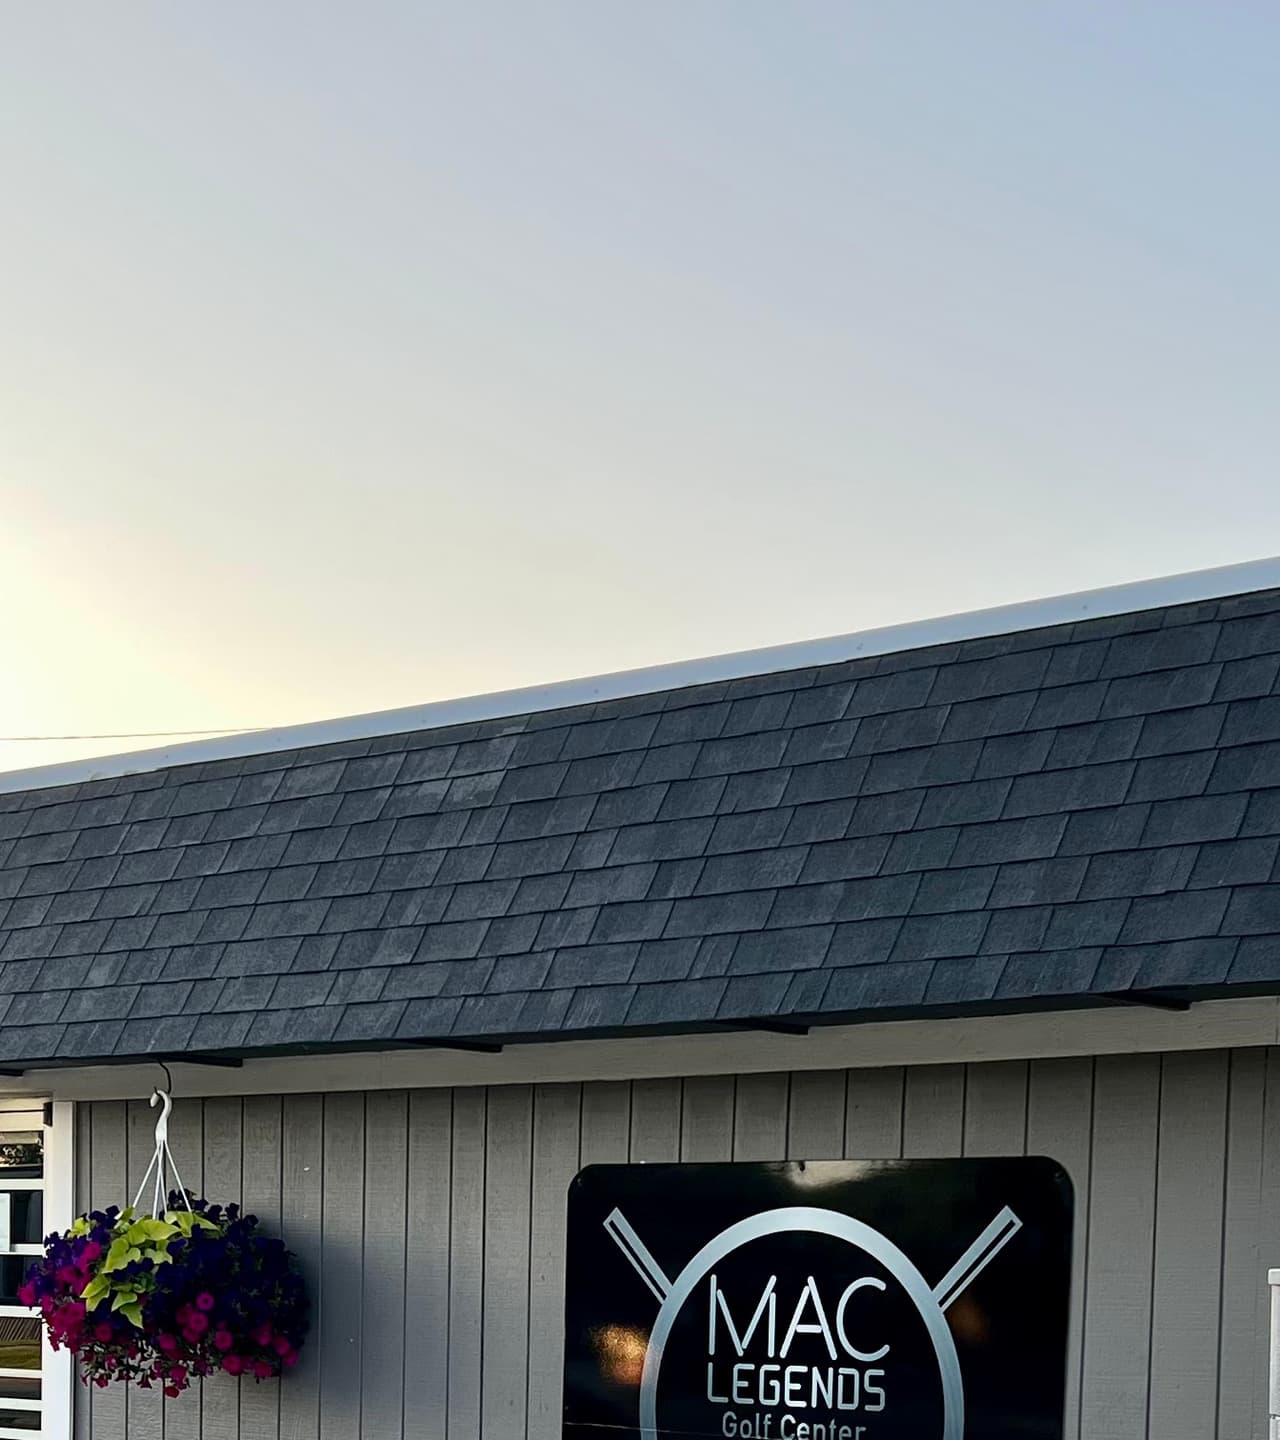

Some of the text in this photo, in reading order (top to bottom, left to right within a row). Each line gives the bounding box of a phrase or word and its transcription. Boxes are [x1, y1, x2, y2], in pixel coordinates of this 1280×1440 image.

[708, 1274, 890, 1362] MAC
[707, 1362, 885, 1412] LEGENDS
[722, 1411, 772, 1440] Golf
